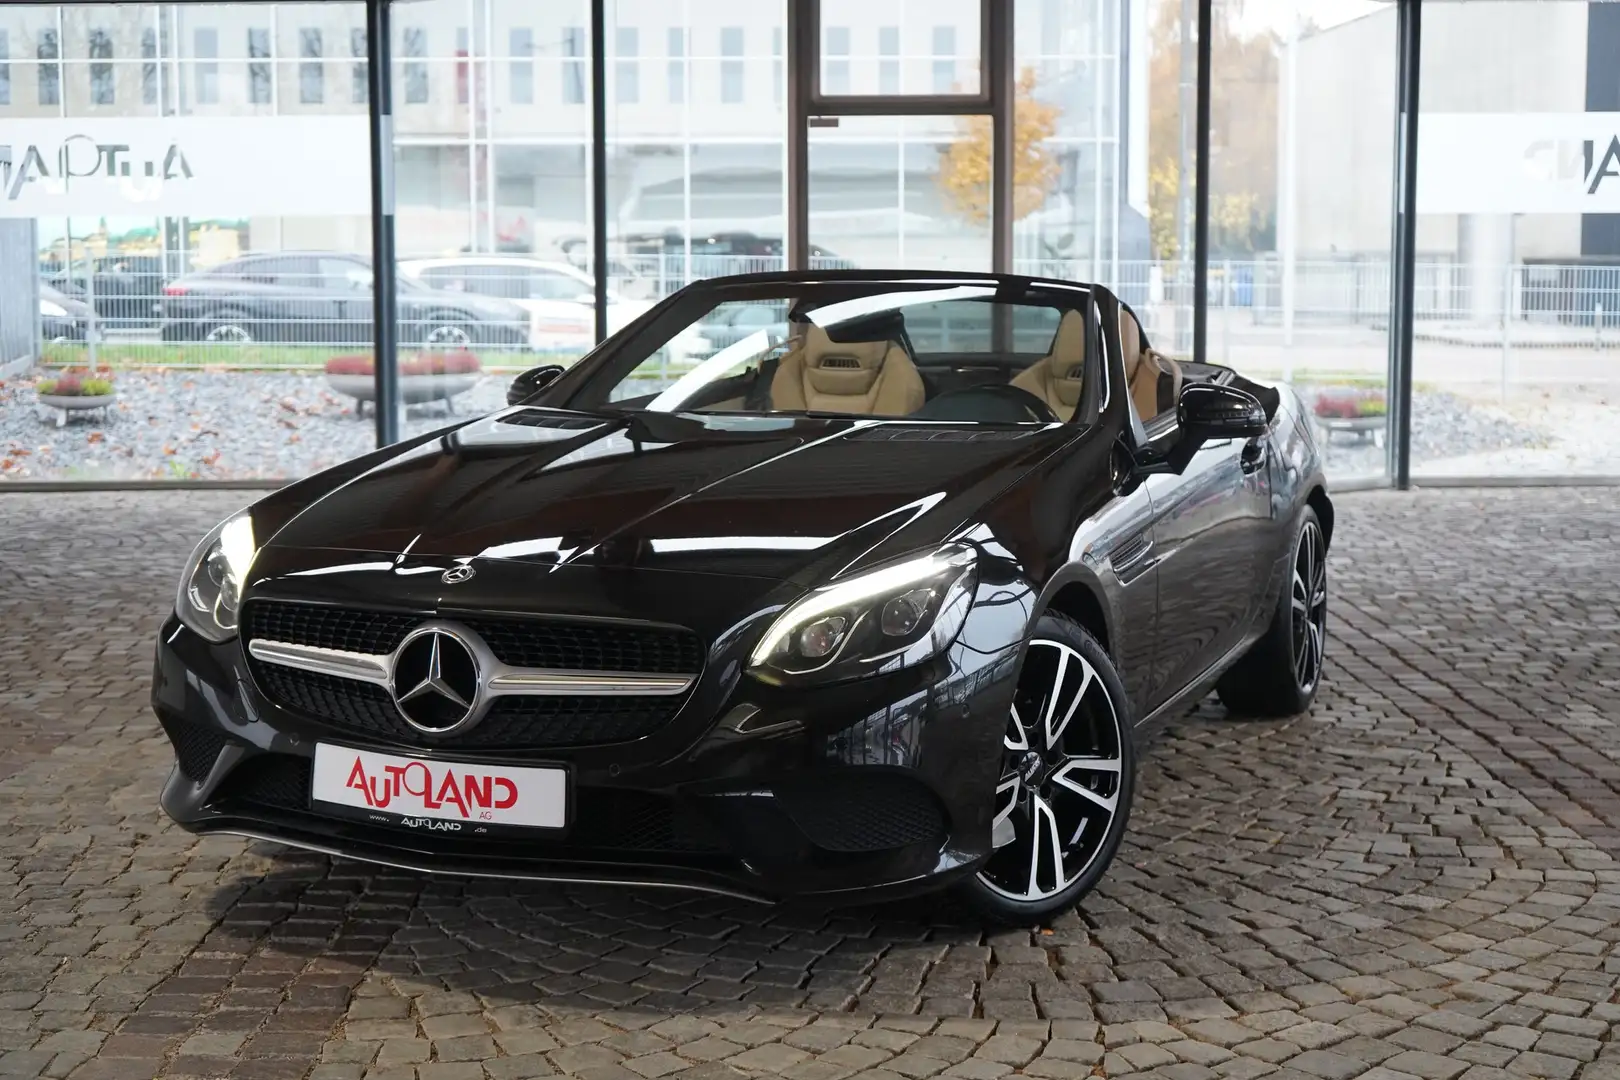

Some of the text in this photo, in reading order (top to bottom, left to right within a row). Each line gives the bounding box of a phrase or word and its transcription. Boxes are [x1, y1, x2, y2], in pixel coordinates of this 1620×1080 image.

[345, 755, 518, 818] AUTOLAND
[369, 814, 390, 822] www.
[401, 817, 461, 831] AUTOLAND
[479, 810, 492, 820] AG
